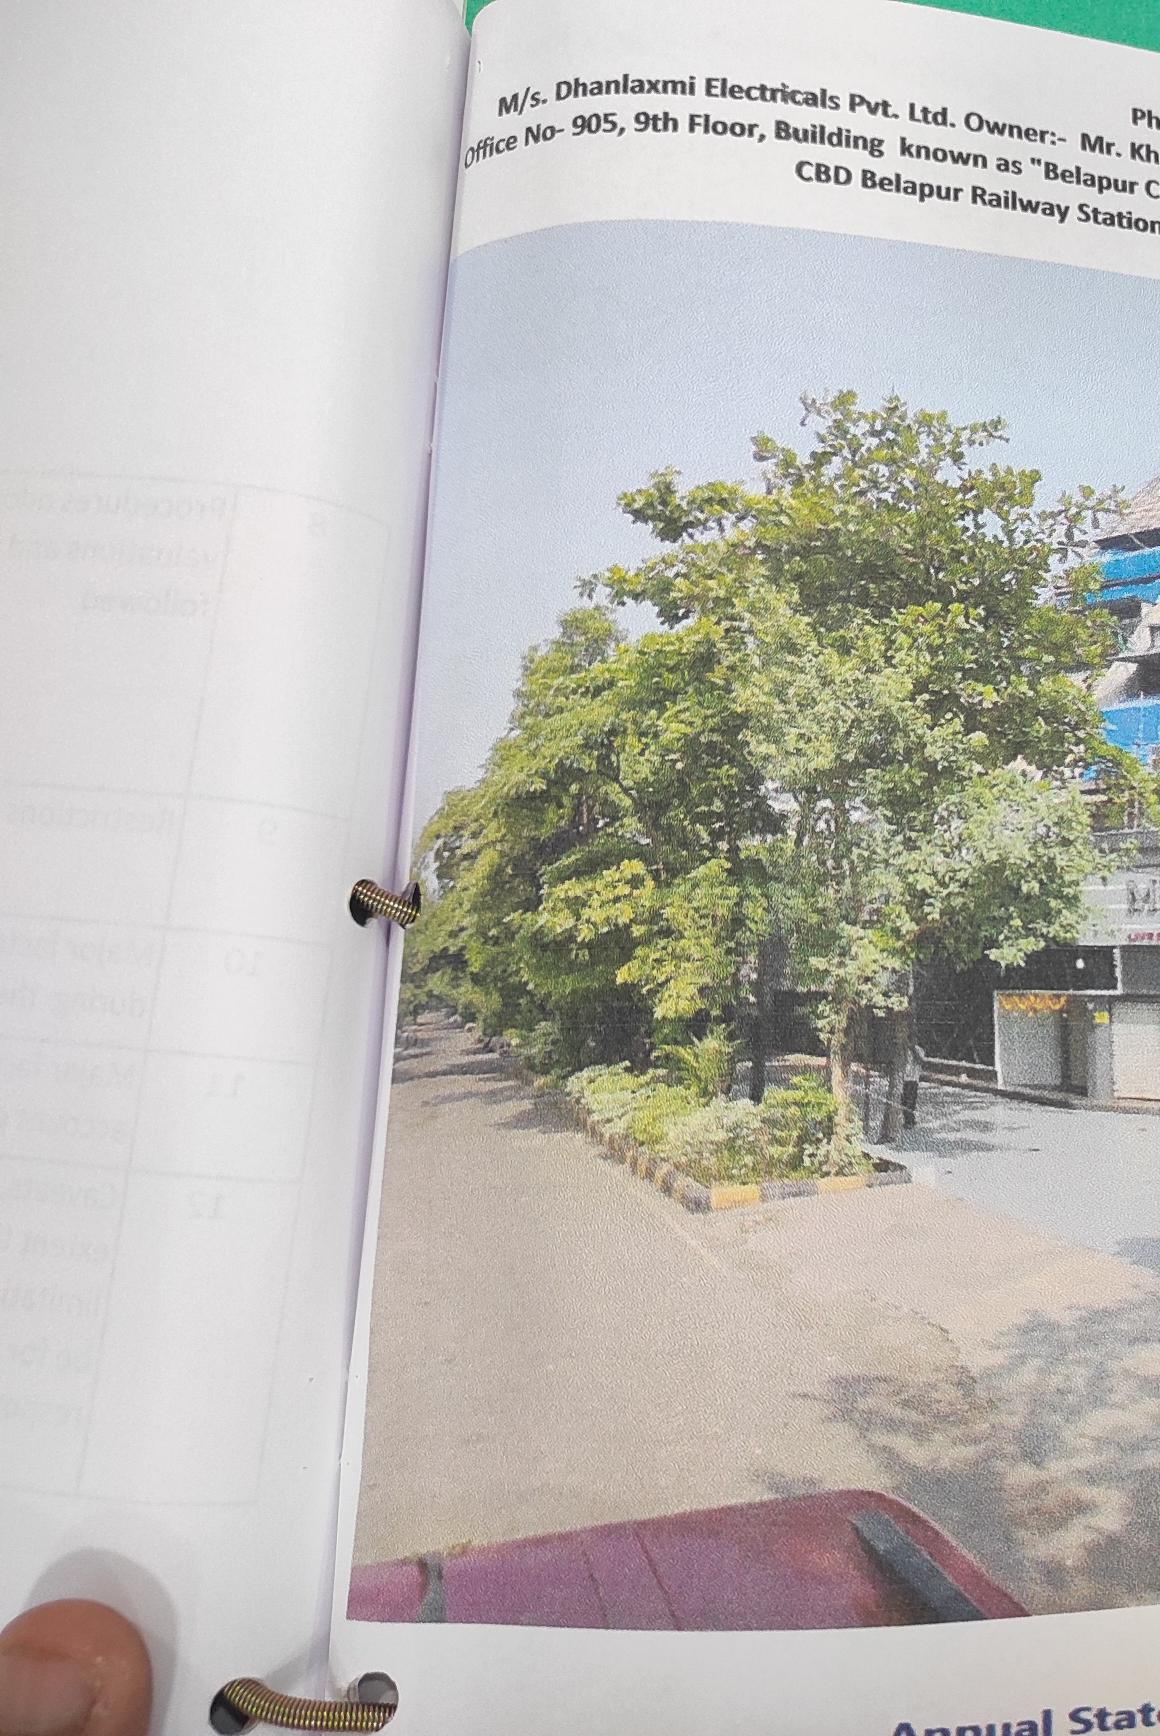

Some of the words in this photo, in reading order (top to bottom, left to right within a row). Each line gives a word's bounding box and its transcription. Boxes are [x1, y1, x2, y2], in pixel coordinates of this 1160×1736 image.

[464, 134, 518, 169] Office
[525, 124, 565, 147] No-
[572, 113, 626, 138] 905,
[634, 112, 679, 134] 9th
[689, 114, 767, 144] Floor,
[775, 120, 885, 159] Building
[900, 136, 988, 170] known
[996, 157, 1023, 176] as
[1030, 157, 1140, 195] "Belapur
[498, 87, 547, 118] M/s.
[556, 74, 697, 102] Dhanlaxmi
[705, 78, 841, 111] Electricals
[849, 93, 900, 120] Pvt.
[909, 103, 957, 129] Ltd.
[964, 112, 1067, 147] Owner:-
[1081, 133, 1123, 158] Mr.
[795, 161, 853, 186] CBD
[862, 169, 964, 203] Belapur
[971, 186, 1071, 225] Railway
